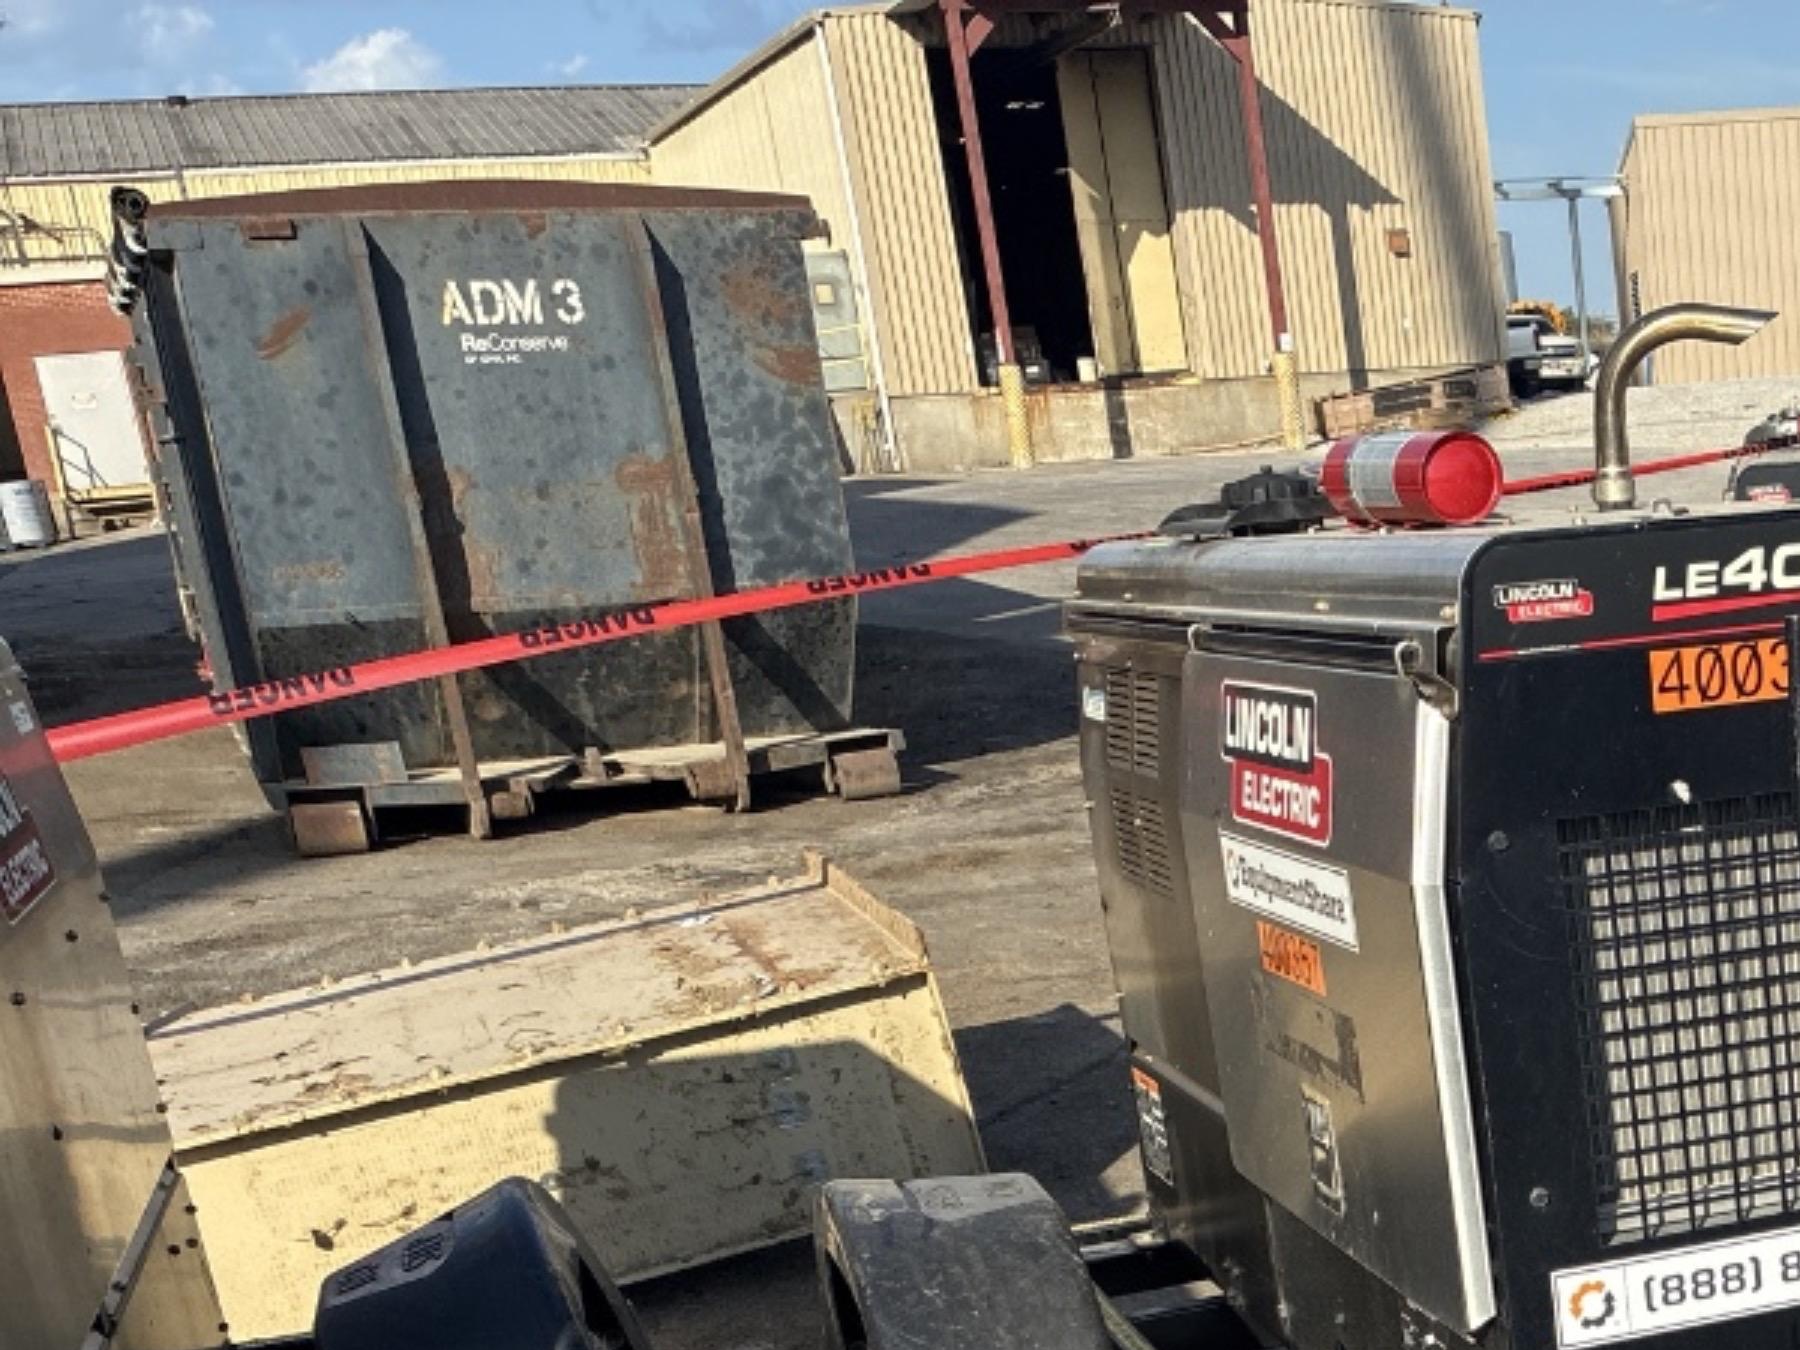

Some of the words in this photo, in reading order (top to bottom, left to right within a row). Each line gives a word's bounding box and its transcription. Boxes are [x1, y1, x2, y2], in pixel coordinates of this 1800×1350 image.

[442, 278, 544, 325] ADM
[552, 278, 586, 325] 3
[460, 332, 570, 351] ReConserve
[1498, 582, 1574, 604] LINCOLN
[1225, 695, 1311, 763] LINCOLN
[1241, 770, 1321, 829] ELECTRIC
[1643, 1256, 1763, 1313] (888)
